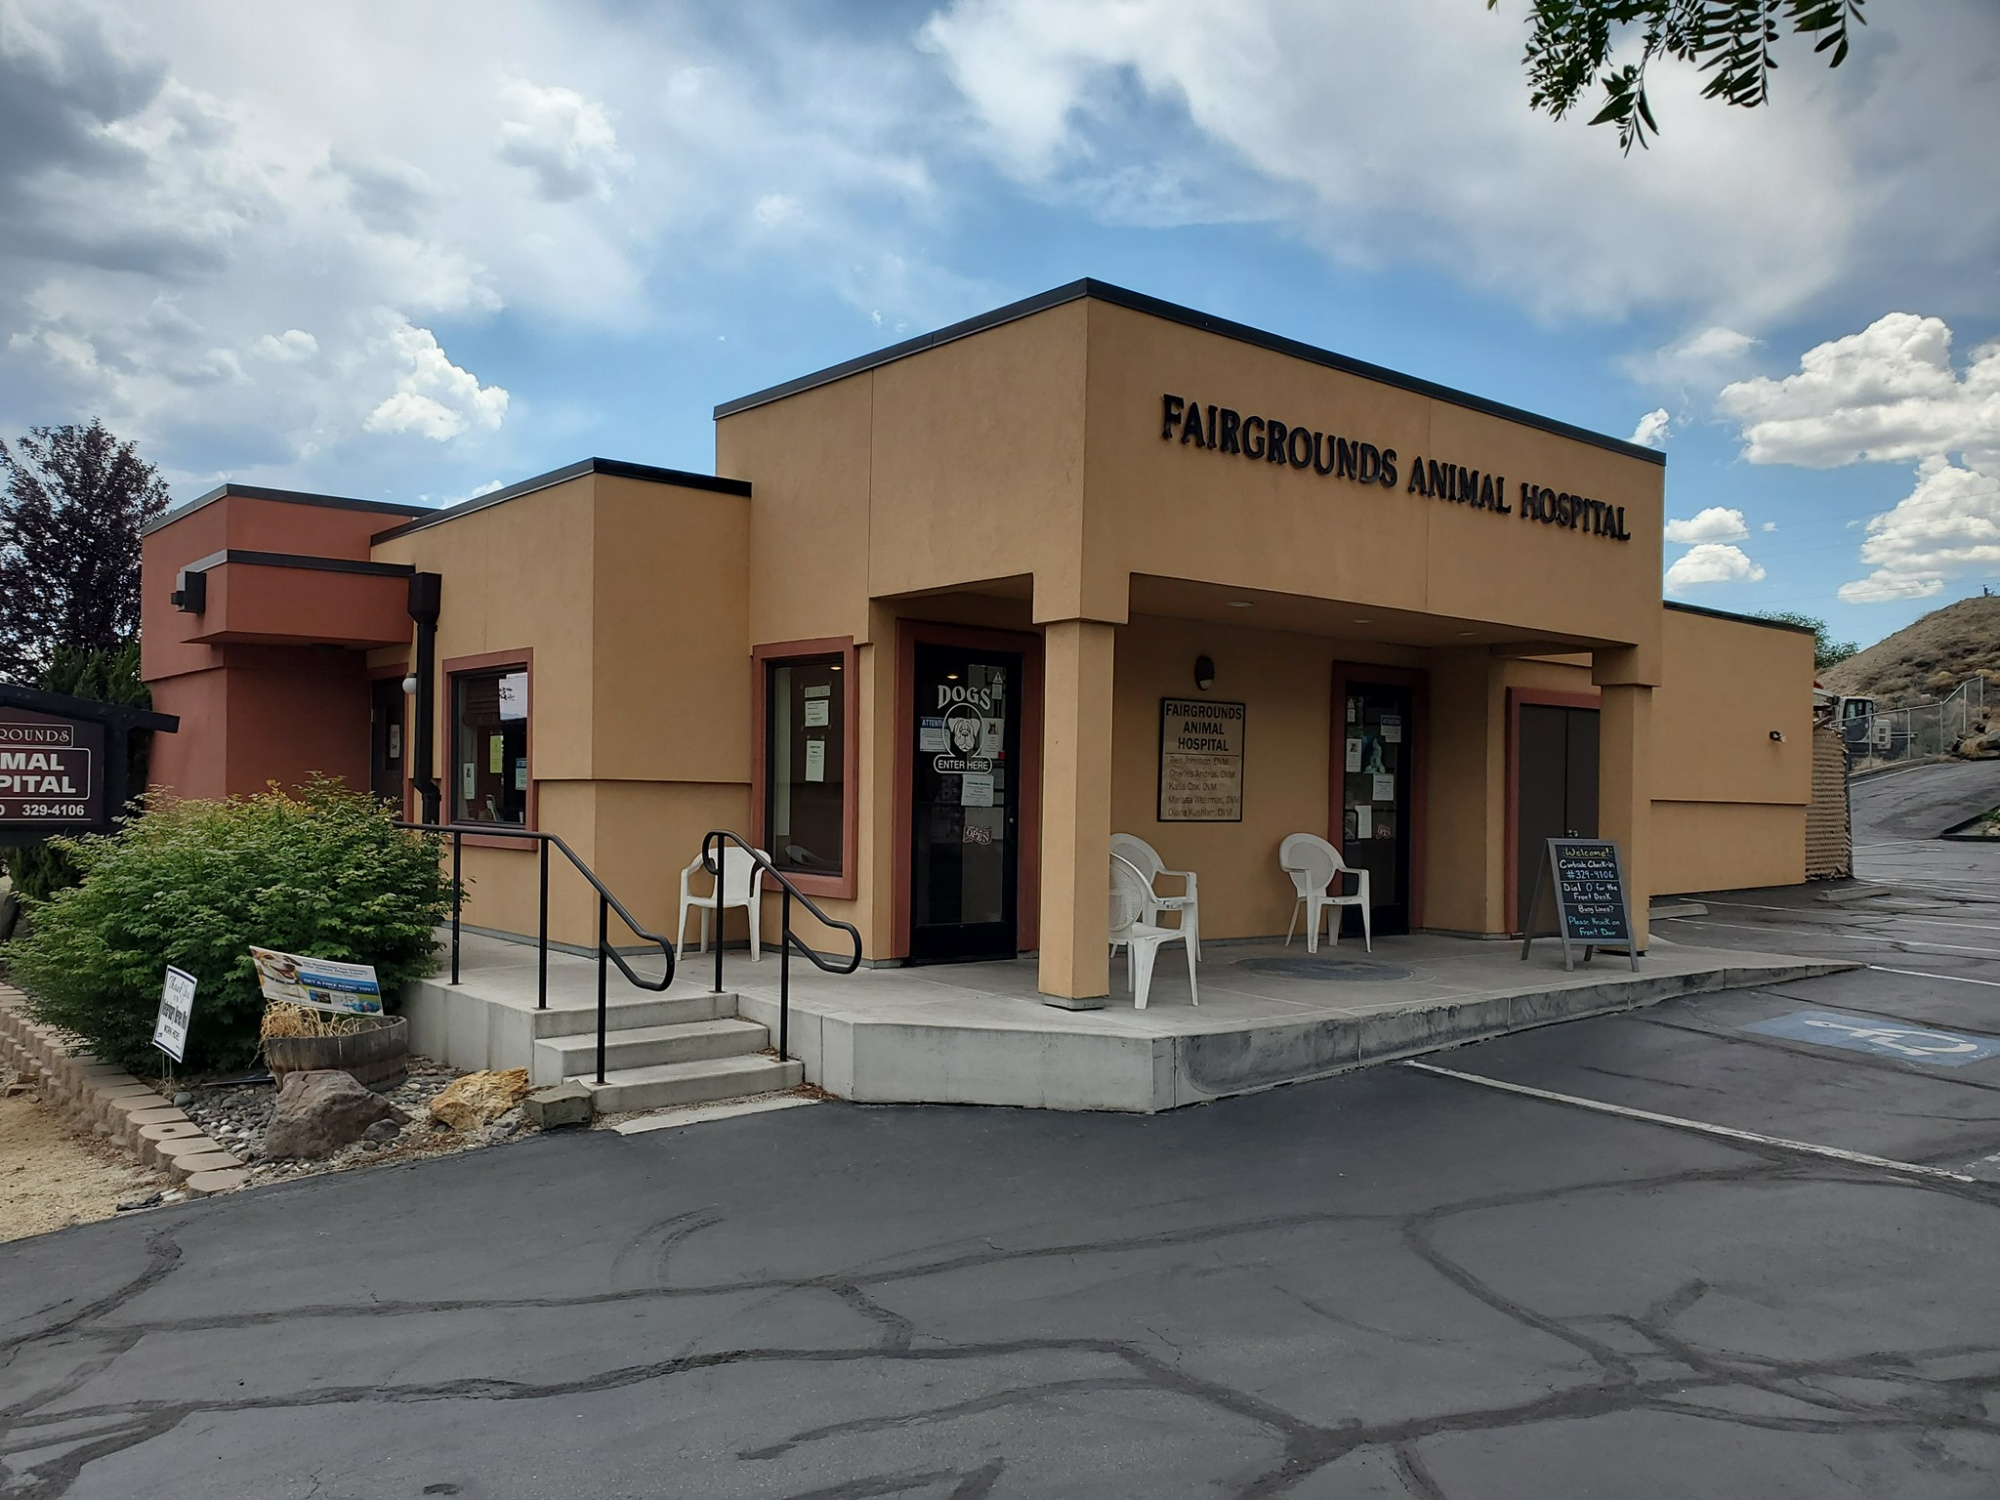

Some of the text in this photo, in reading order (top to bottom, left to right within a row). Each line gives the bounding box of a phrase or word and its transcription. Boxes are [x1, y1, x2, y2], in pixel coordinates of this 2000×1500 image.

[1161, 393, 1631, 541] FAIRGROUNDS ANIMAL HOSPITAL
[937, 685, 991, 710] DOGS
[1165, 703, 1242, 720] FAIRGROUNDS
[1182, 721, 1225, 735] ANIMAL
[1177, 737, 1229, 751] HOSPITAL
[0, 752, 65, 771] MAL
[938, 759, 989, 770] ENTER HERE
[22, 804, 85, 816] 329-4106
[966, 828, 989, 843] OPEN
[1565, 847, 1610, 857] Welcome!
[1566, 870, 1614, 879] #329-4106
[1563, 882, 1581, 892] Dial
[1573, 892, 1612, 901] Front Desk
[1579, 927, 1598, 936] Front
